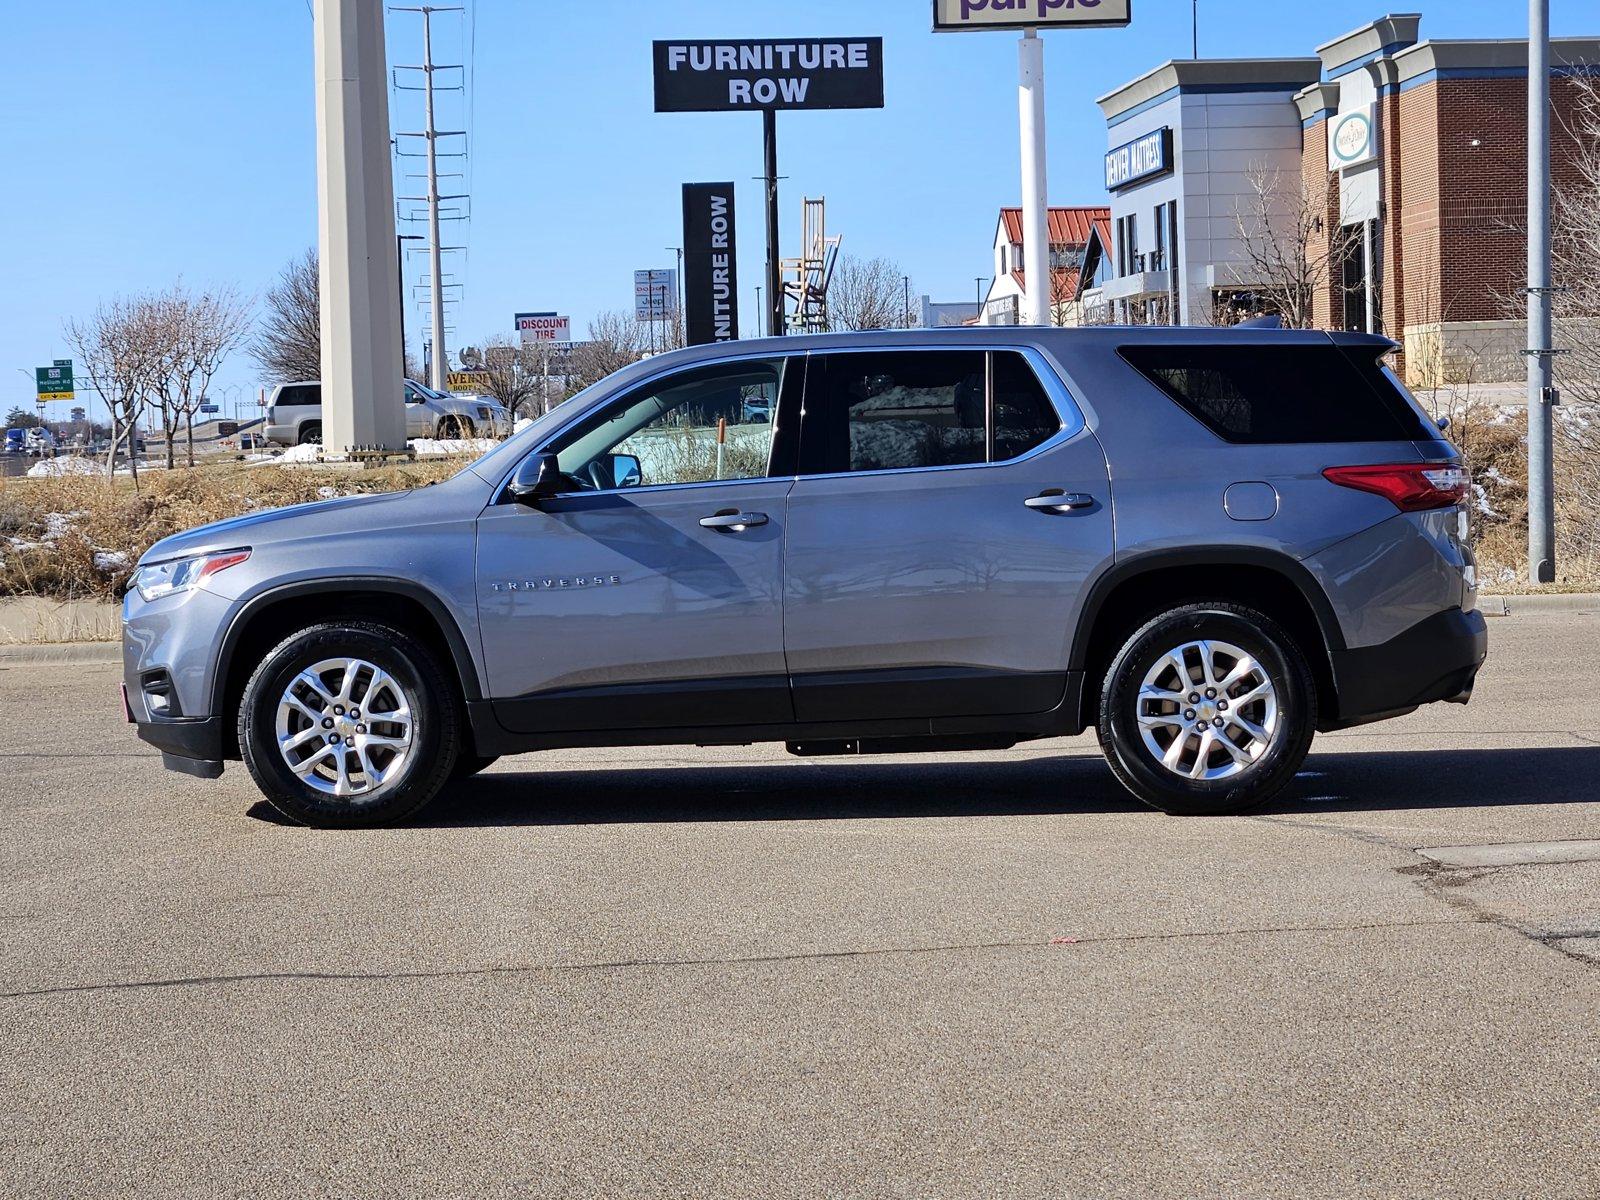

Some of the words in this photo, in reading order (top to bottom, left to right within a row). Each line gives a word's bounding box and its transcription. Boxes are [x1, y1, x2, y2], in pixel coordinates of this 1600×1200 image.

[667, 43, 869, 71] FURNITURE
[728, 77, 810, 104] ROW
[1106, 147, 1130, 187] DENVER
[1131, 133, 1160, 177] MATTRESS
[710, 195, 729, 248] ROW
[521, 318, 568, 330] DISCOUNT
[535, 330, 556, 339] TIRE
[491, 575, 621, 591] TRAVERSE
